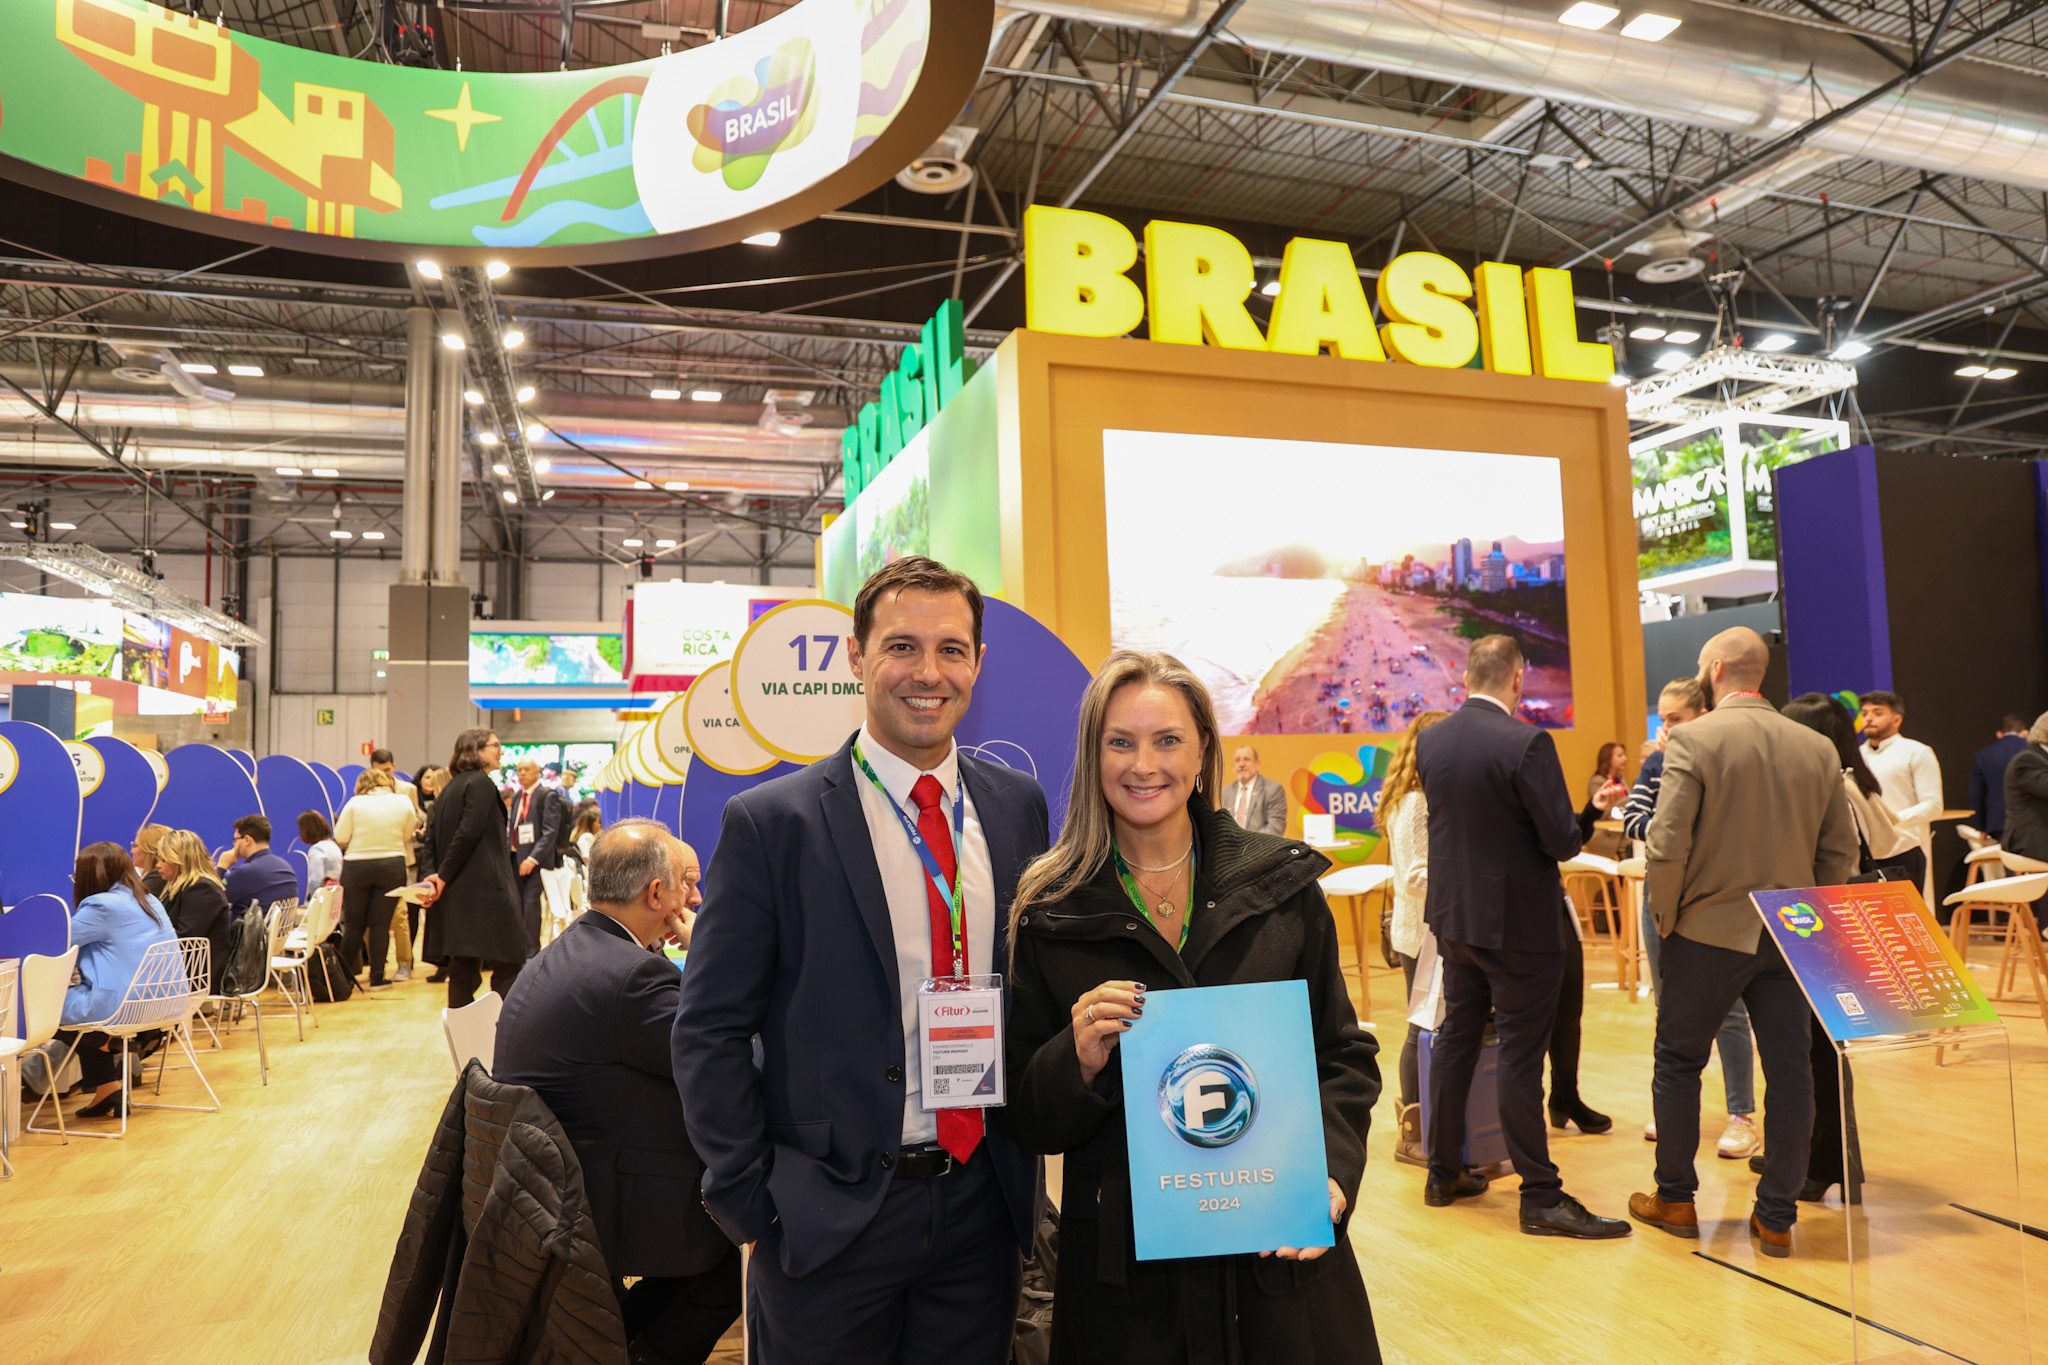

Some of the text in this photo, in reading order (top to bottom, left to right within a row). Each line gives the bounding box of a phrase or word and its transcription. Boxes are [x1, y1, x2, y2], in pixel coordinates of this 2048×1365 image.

[725, 94, 798, 144] BRASIL
[1024, 203, 1616, 383] BRASIL
[842, 298, 974, 509] BRASIL
[1660, 511, 1675, 525] DE
[1656, 520, 1700, 538] BRASIL
[682, 629, 731, 641] COSTA
[683, 643, 719, 655] RICA
[789, 635, 839, 671] 17
[761, 683, 865, 695] VIA CAPI DMC
[703, 718, 740, 728] VIA CA
[674, 746, 691, 754] OPE
[1328, 791, 1382, 815] BRAS
[1790, 916, 1814, 925] BRASIL
[941, 1006, 965, 1016] Fitur
[1183, 1071, 1232, 1129] F
[1160, 1167, 1276, 1190] FESTURIS
[1198, 1197, 1241, 1212] 2024
